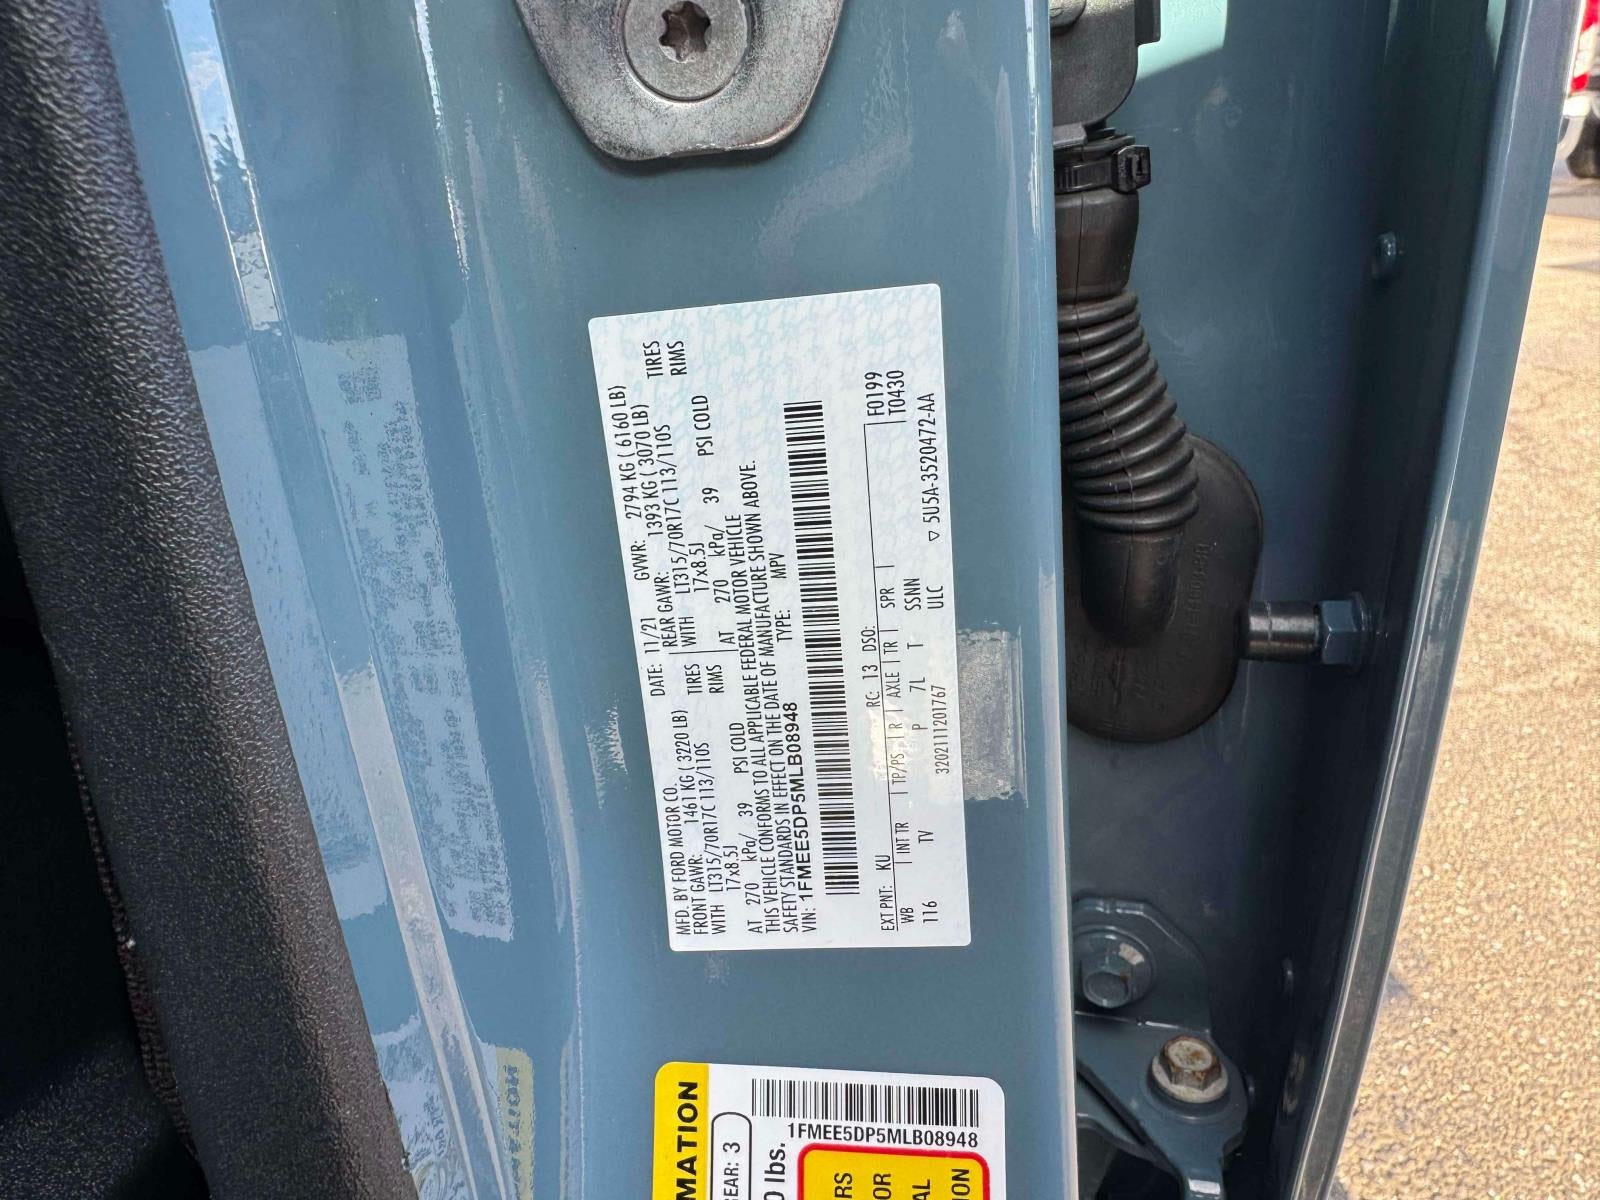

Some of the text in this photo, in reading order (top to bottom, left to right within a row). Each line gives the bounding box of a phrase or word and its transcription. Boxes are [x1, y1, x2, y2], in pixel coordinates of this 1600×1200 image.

[643, 341, 663, 379] TIRES
[666, 341, 687, 376] RIMS
[608, 386, 626, 407] LB)
[864, 372, 885, 416] F0199
[886, 370, 906, 416] T0430
[611, 413, 632, 447] 6160
[630, 404, 649, 426] LB)
[634, 431, 654, 466] 3070
[917, 393, 940, 523] 5U5A-3520472-AA
[619, 463, 636, 481] KG
[622, 486, 642, 519] 2794
[641, 481, 659, 499] KG
[644, 504, 663, 537] 1393
[653, 425, 696, 647] WITH LT315/70R17C 113/110S
[691, 395, 736, 644] AT 270 kPa/ 39 PSI COLD
[630, 540, 650, 580] GVWR:
[688, 543, 710, 592] 17x8.5J
[654, 572, 673, 612] GAWR:
[768, 553, 792, 642] TYPE: MPV
[880, 588, 895, 608] SPR
[903, 578, 921, 611] SSNN
[926, 586, 944, 609] ULC
[659, 617, 678, 647] REAR
[883, 641, 898, 655] TR
[640, 618, 665, 696] DATE: 11/21
[861, 626, 880, 707] RC: 13 DSO:
[684, 664, 703, 695] TIRES
[706, 665, 724, 693] RIMS
[739, 460, 798, 932] SAFETY STANDARDS IN EFFECT ON THE DATE OF MANUFACTURE SHOWN ABOVE.
[885, 672, 901, 698] AXLE
[909, 677, 926, 692] 7L
[671, 710, 688, 728] LB)
[725, 514, 780, 934] THIS VEHICLE CONFORMS TO ALL APPLICABLE FEDERAL MOTOR VEHICLE
[931, 685, 949, 774] 3202111201767
[674, 733, 692, 762] 3220
[679, 775, 695, 790] KG
[889, 754, 907, 785] TP/PS
[682, 797, 699, 824] 1461
[729, 723, 763, 933] AT 270 kPa/ 39 PSI COLD
[782, 702, 816, 932] VIN: 1FMEE5DP5MLB08948
[693, 743, 726, 934] WITH LT315/70R17C 113/110S
[895, 822, 910, 854] INT TR
[918, 830, 934, 843] TV
[663, 783, 691, 935] MFD. BY FORD MOTOR CO.
[688, 854, 705, 892] GAWR:
[723, 846, 741, 891] 17x8.5J
[875, 855, 895, 930] EXT PNT: KU
[691, 897, 708, 934] FRONT
[900, 908, 914, 923] WB
[922, 901, 938, 923] 116
[676, 1081, 698, 1200] MATION
[787, 1123, 978, 1148] 1FMEE5DP5MLB08948
[723, 1142, 740, 1200] EAR: 3
[764, 1143, 786, 1182] lbs.
